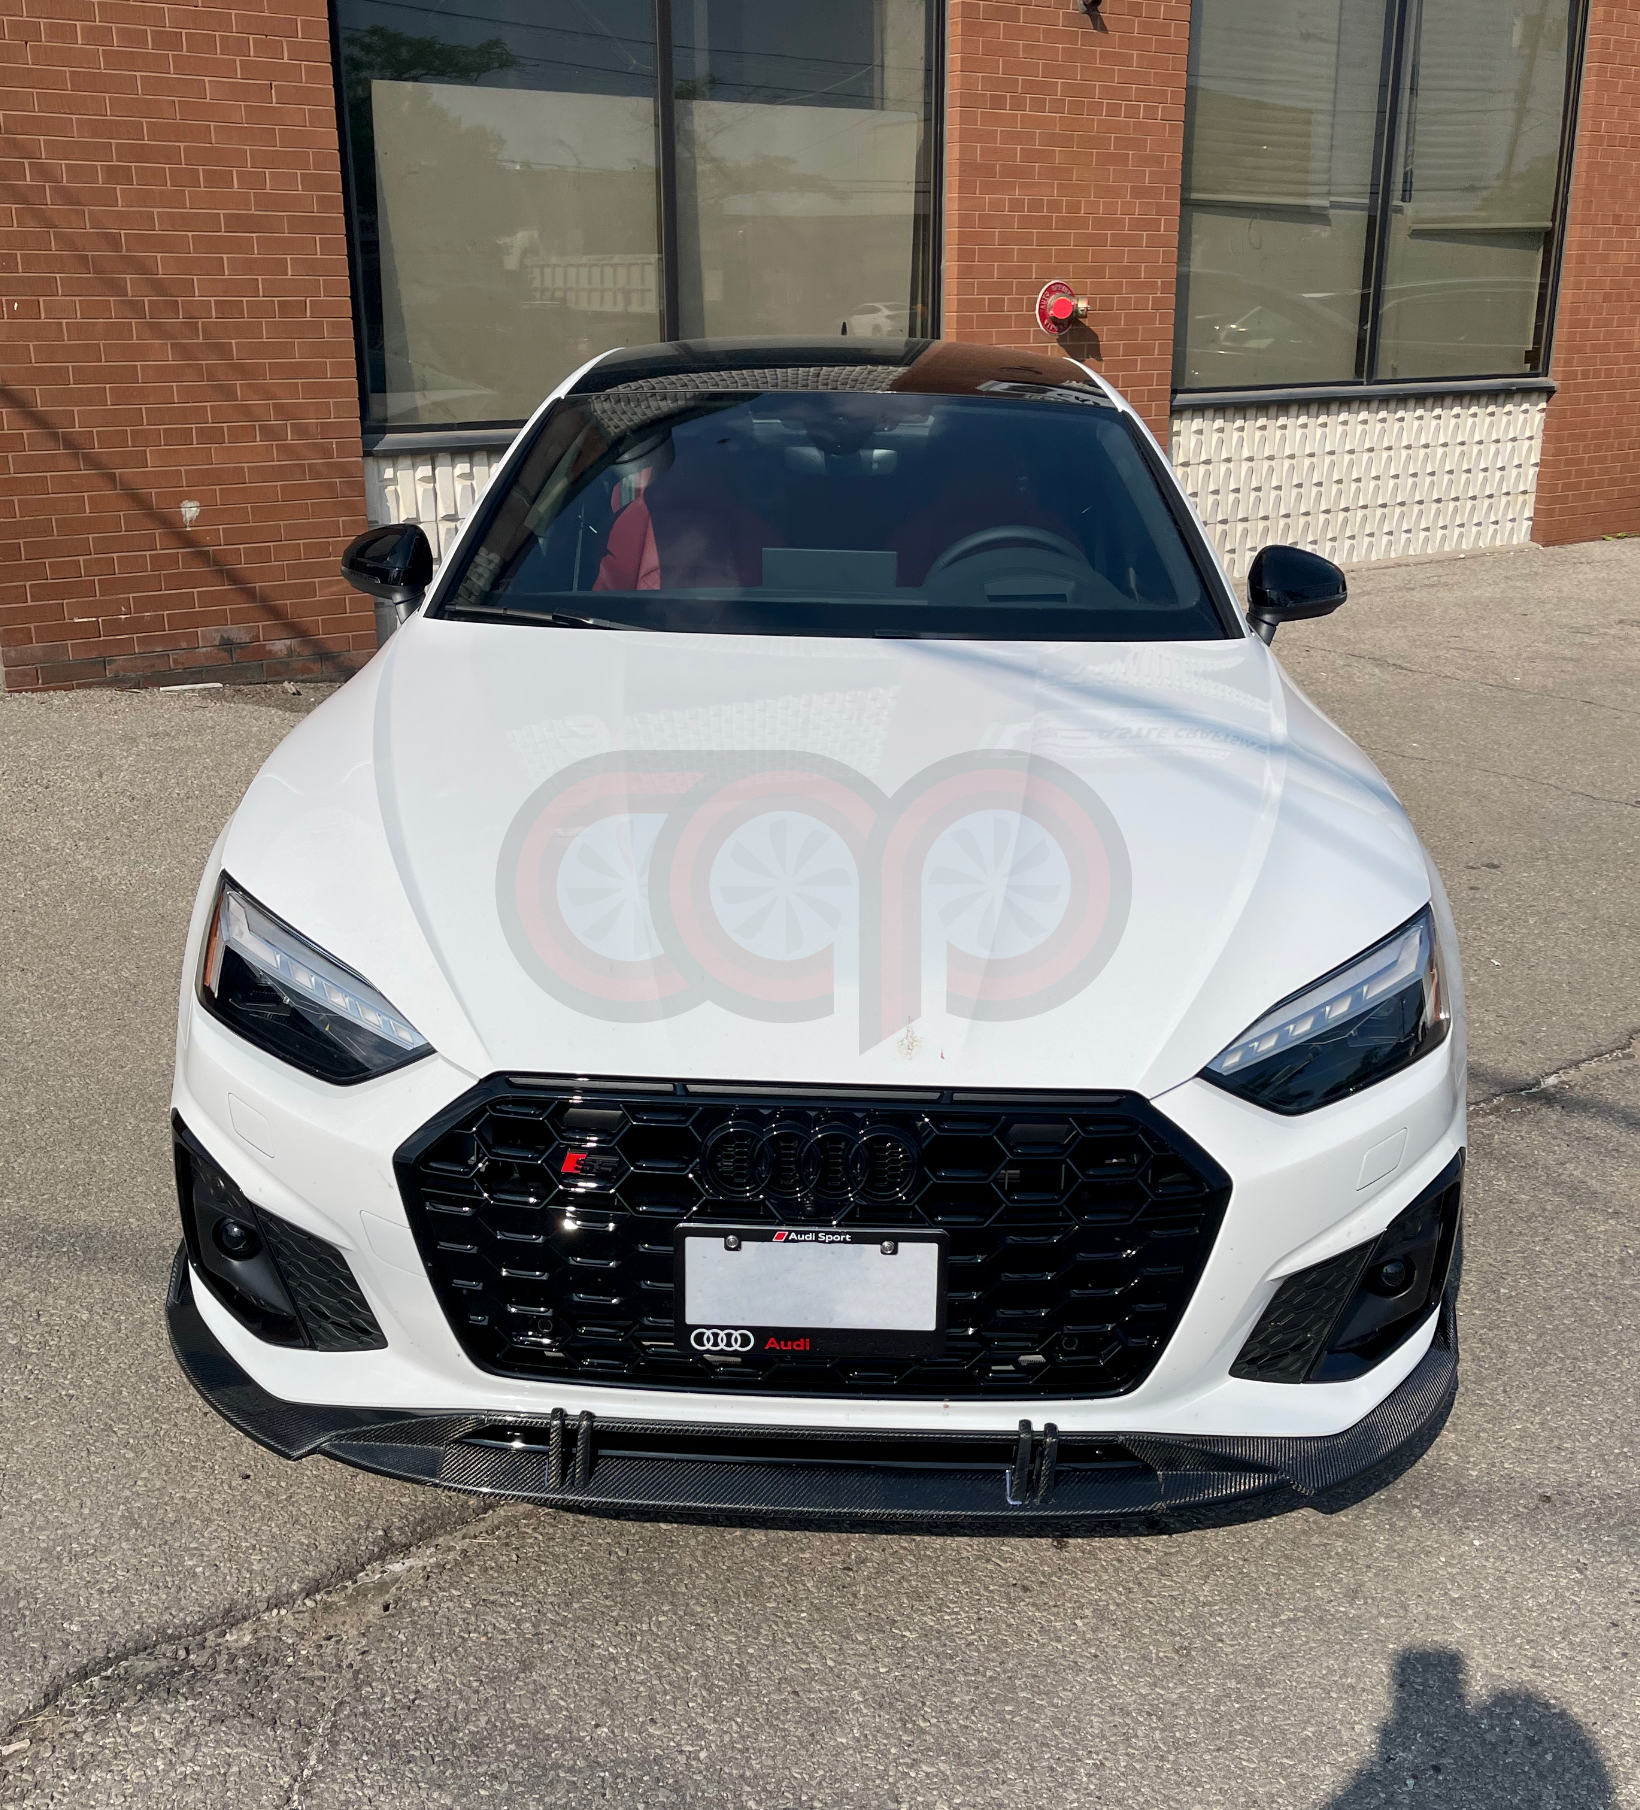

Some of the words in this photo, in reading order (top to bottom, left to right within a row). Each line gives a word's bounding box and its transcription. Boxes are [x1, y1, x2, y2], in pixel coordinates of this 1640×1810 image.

[788, 1232, 815, 1241] Audi
[818, 1232, 852, 1243] Sport
[764, 1337, 810, 1351] Audi
